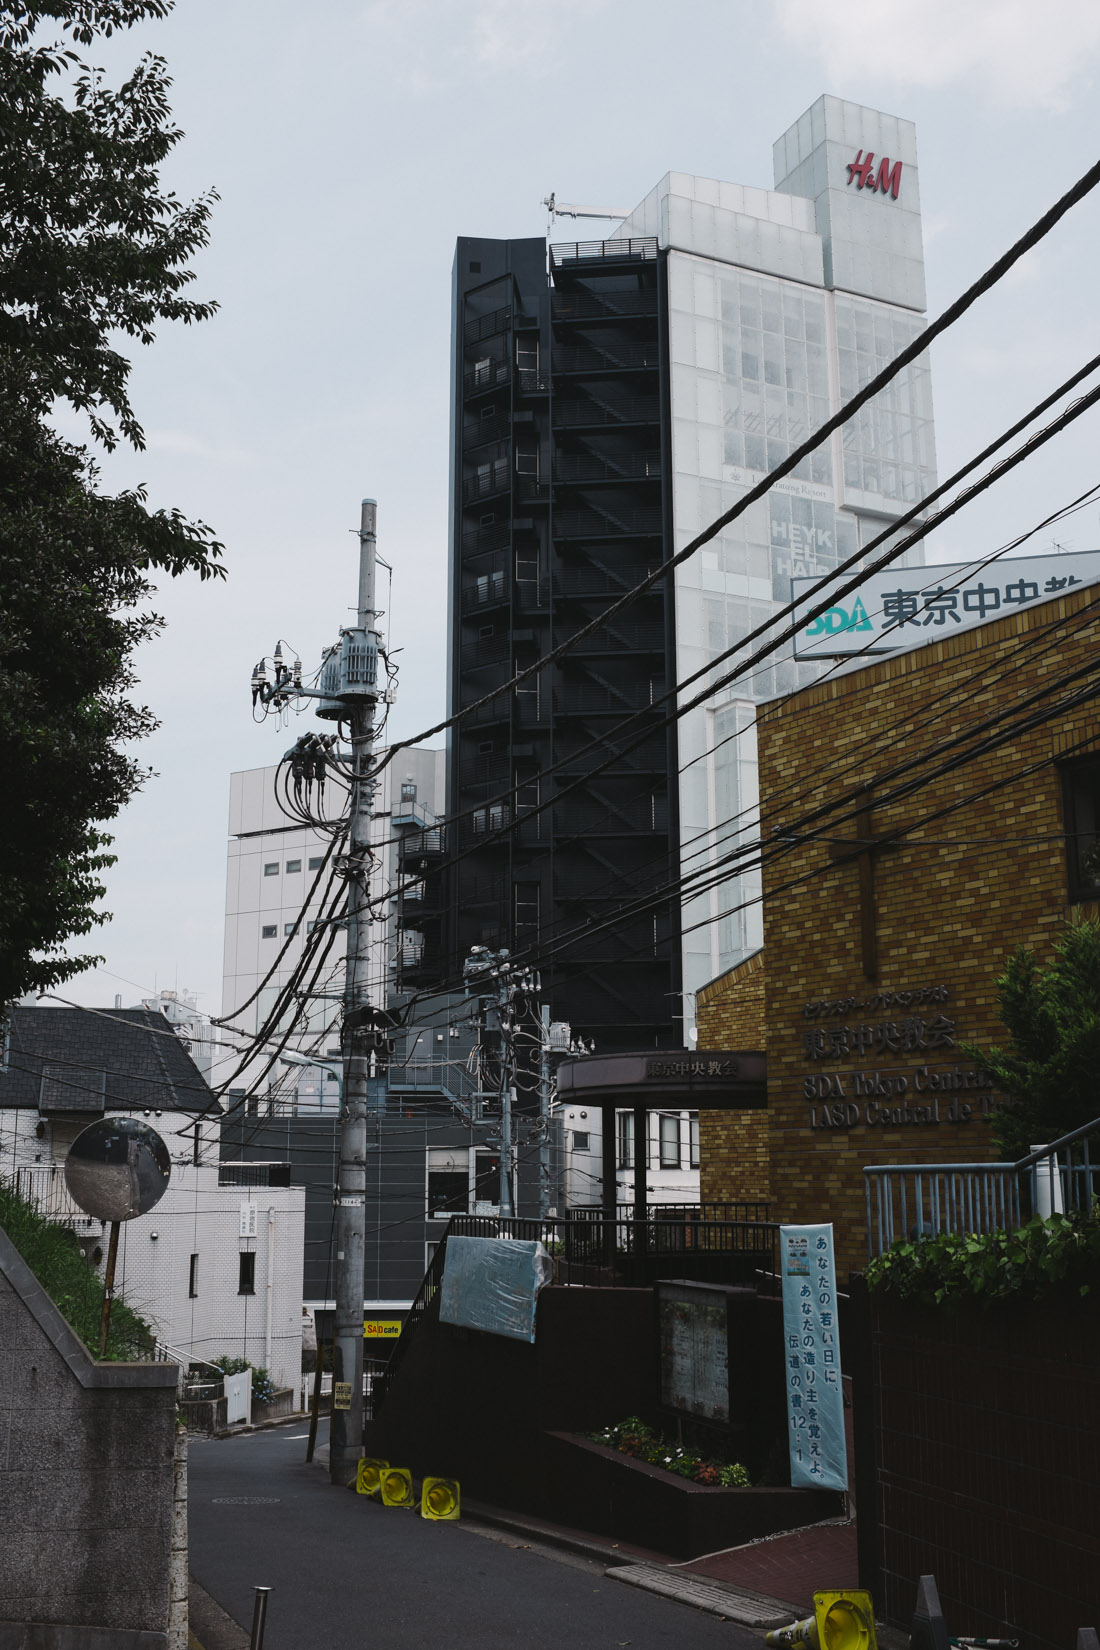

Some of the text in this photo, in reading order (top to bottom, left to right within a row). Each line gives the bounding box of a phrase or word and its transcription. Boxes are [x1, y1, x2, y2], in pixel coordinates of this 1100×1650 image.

[846, 149, 903, 200] H&M
[801, 484, 827, 499] Resort
[771, 519, 833, 548] HEYK
[790, 542, 817, 563] EL
[804, 1013, 956, 1061] 東京中央教会
[647, 1059, 737, 1078] 東京中央教会
[803, 1074, 846, 1099] SDA
[853, 1071, 909, 1100] Tokyo
[865, 1096, 941, 1126] Central
[948, 1095, 973, 1122] de
[816, 1236, 839, 1392] あなたの若い日に、
[367, 1324, 384, 1334] SAD
[384, 1325, 399, 1334] cafe
[800, 1284, 825, 1479] あなたの造り主を覚えよ。
